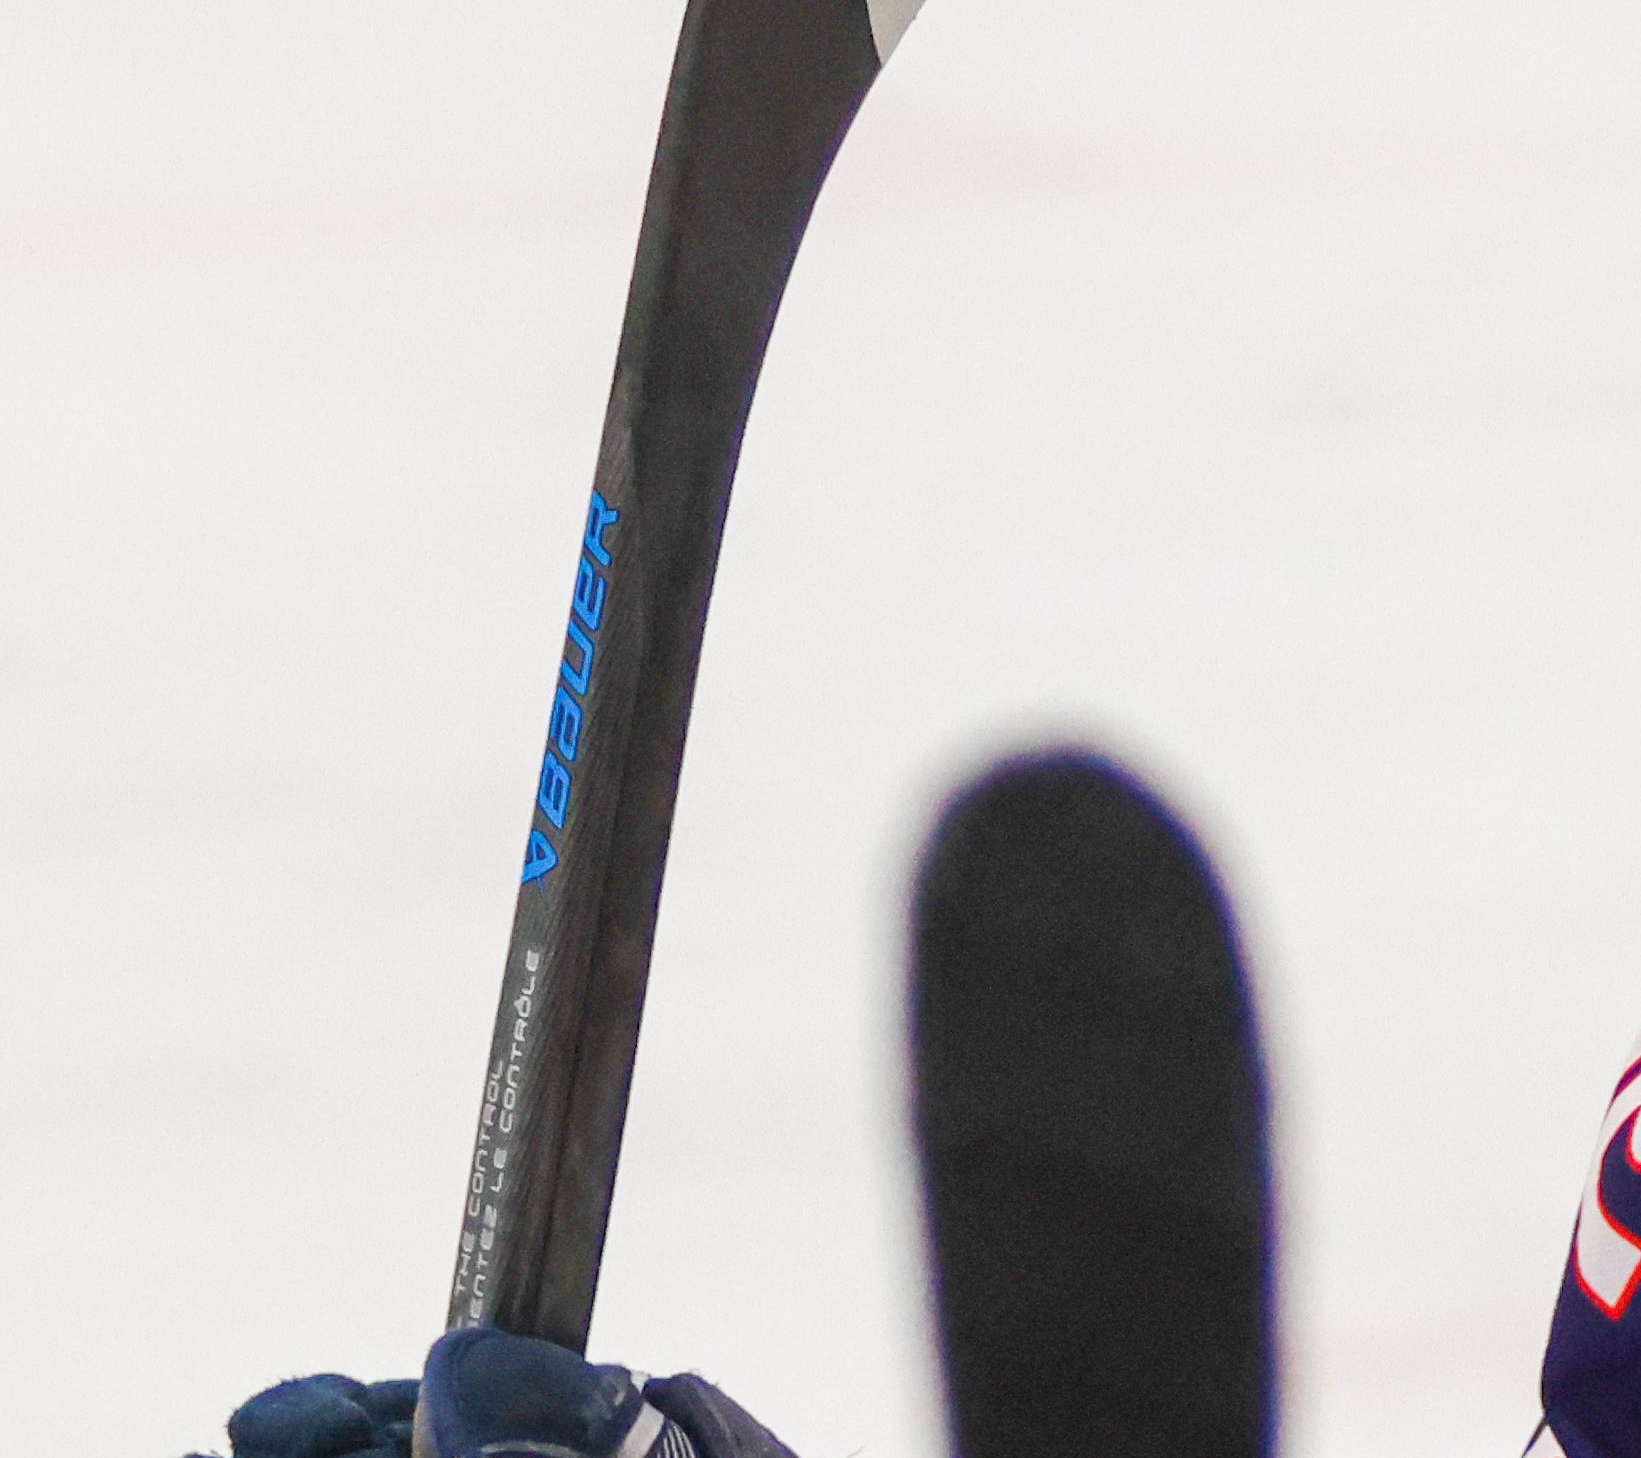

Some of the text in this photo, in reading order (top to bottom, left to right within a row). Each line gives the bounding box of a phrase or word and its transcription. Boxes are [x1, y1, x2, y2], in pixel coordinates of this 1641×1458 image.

[534, 488, 621, 831] BAUER
[452, 1228, 476, 1296] THE
[467, 1059, 503, 1219] CONTROL
[489, 1146, 508, 1194] LE
